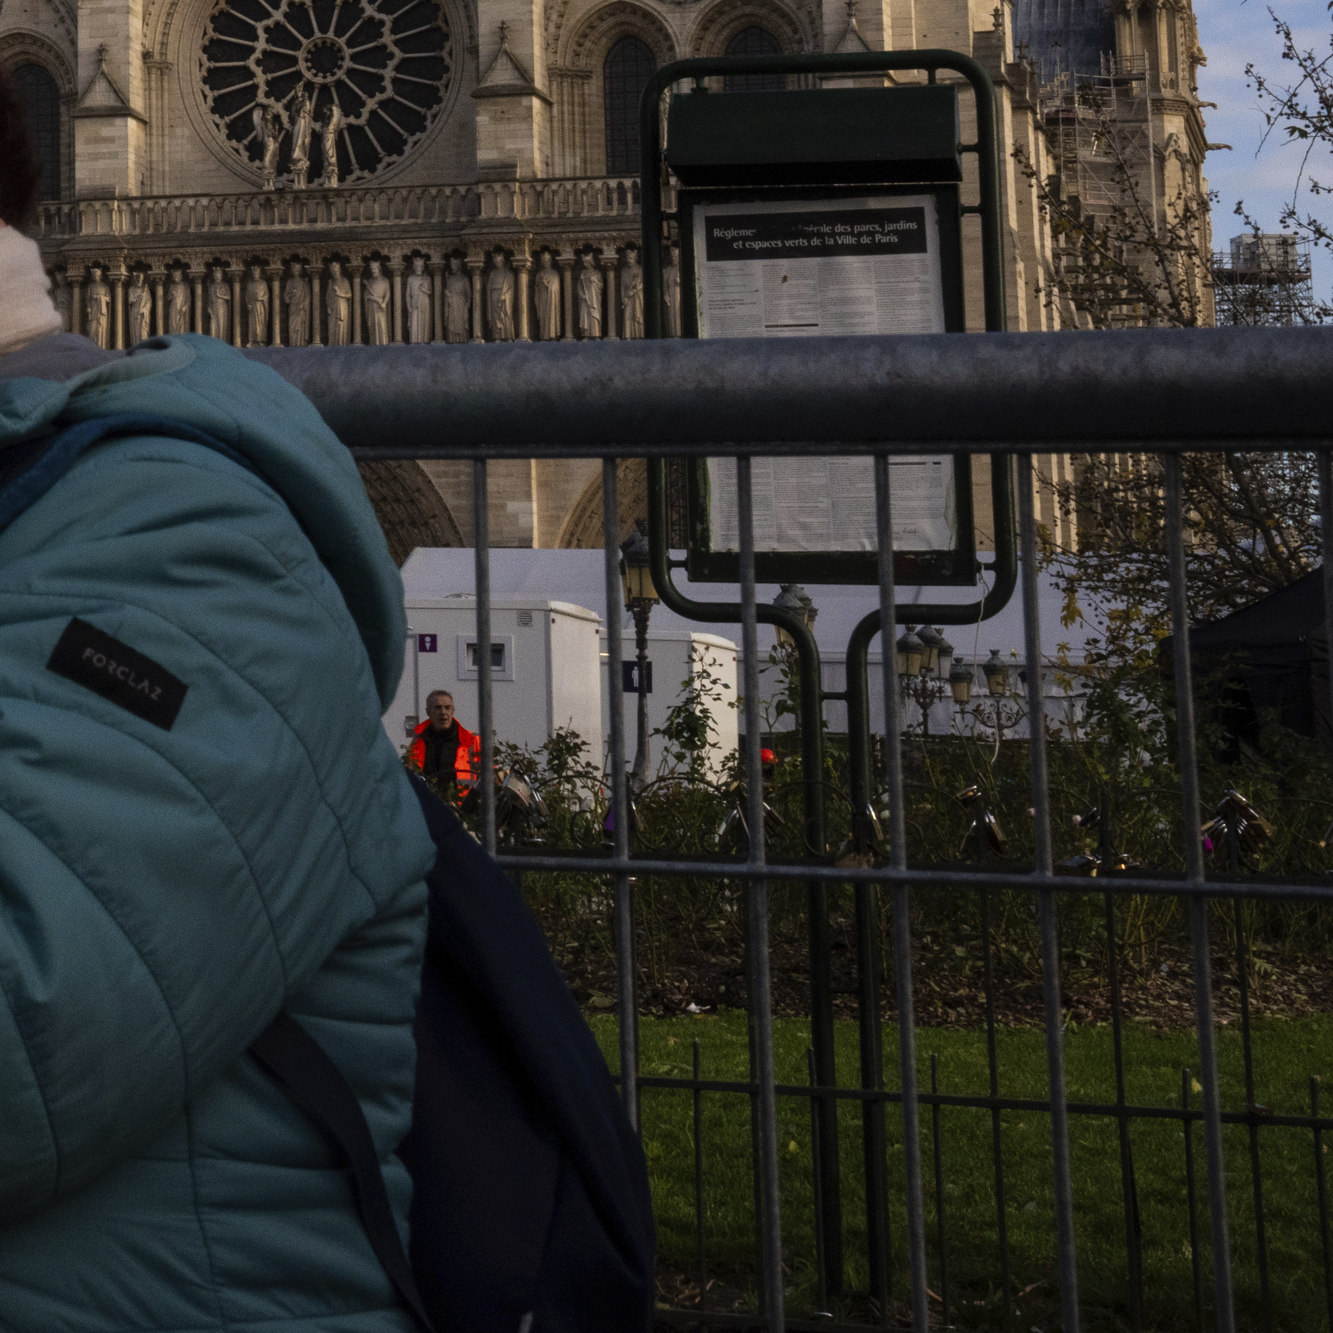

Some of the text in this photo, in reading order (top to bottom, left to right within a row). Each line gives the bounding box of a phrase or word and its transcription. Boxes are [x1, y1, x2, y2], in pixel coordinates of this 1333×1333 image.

[834, 223, 852, 233] des
[854, 223, 882, 234] parcs,
[884, 220, 917, 233] jardins
[733, 233, 898, 250] et espaces verts de la Ville de Paris
[82, 647, 162, 700] FORCLAZ
